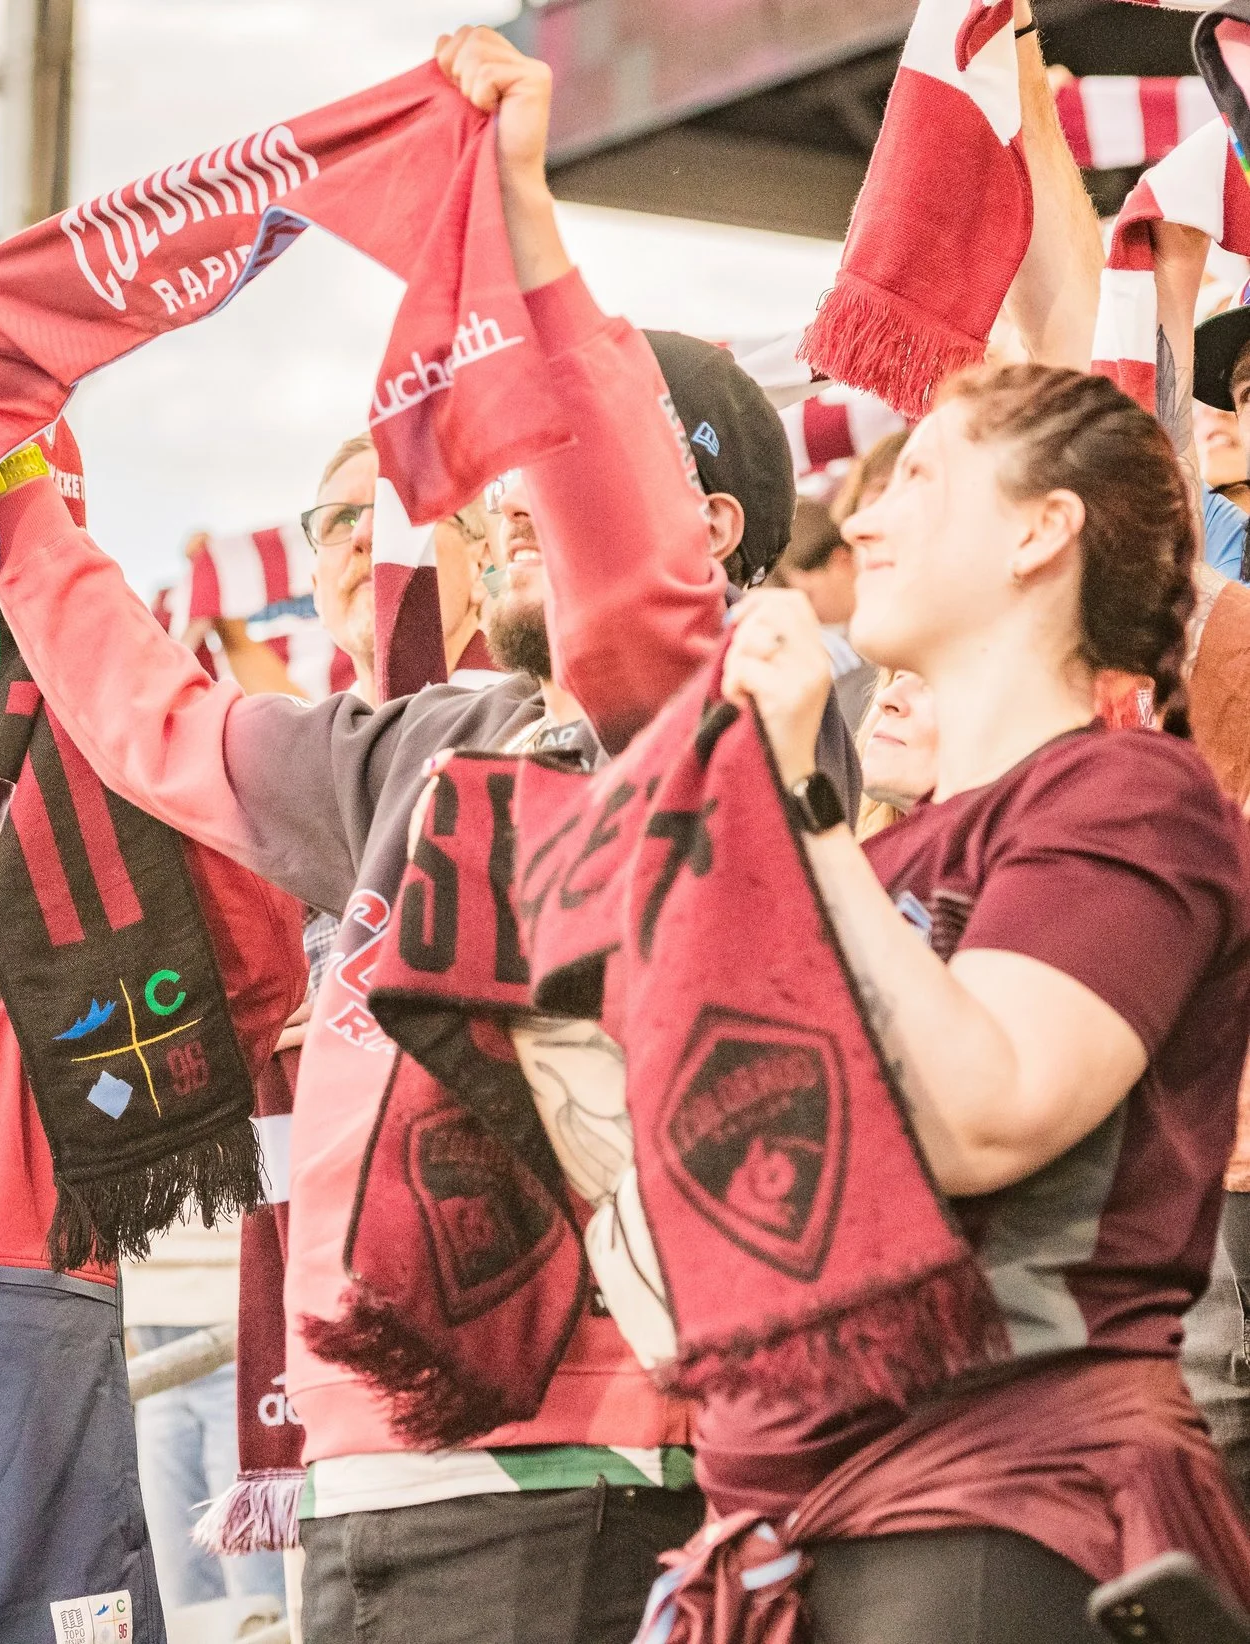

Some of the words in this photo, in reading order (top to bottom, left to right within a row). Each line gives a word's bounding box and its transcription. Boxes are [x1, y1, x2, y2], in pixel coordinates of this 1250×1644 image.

[144, 969, 186, 1016] C
[167, 1041, 210, 1095] 96
[64, 1628, 85, 1639] TOPO
[118, 1623, 127, 1639] 96
